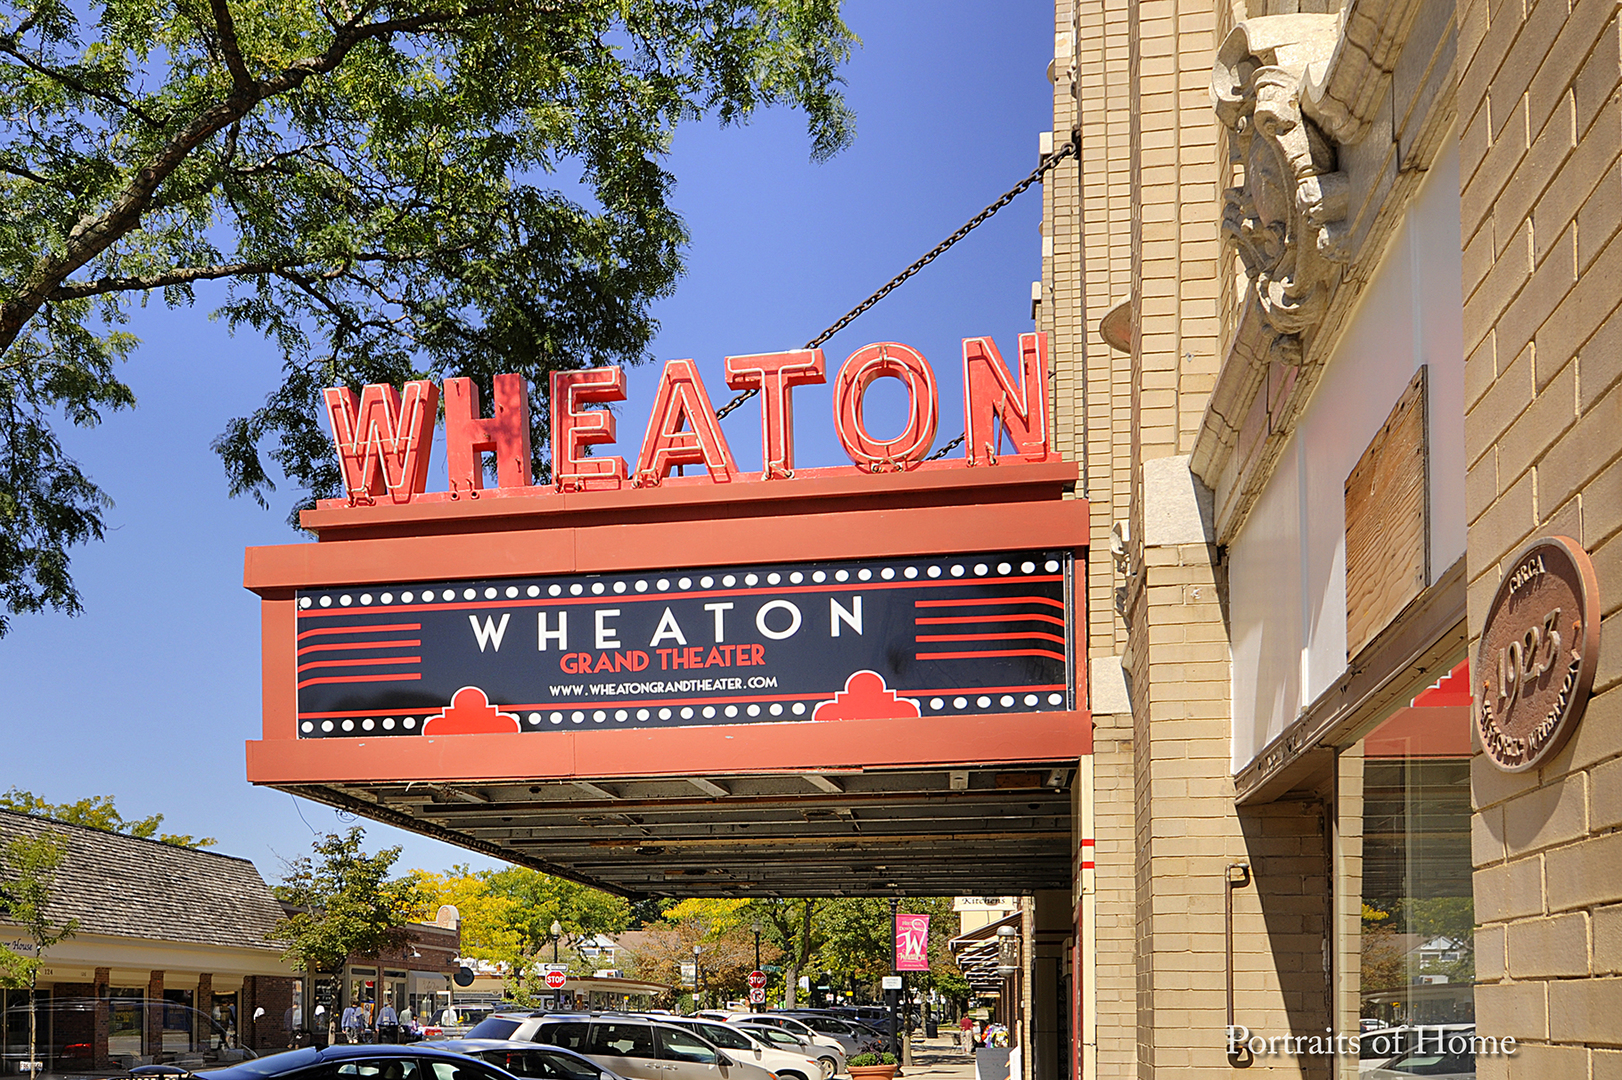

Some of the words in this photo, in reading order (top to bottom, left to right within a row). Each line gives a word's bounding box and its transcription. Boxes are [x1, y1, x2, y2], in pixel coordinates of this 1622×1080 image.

[323, 331, 1049, 503] WHEATON
[1509, 555, 1546, 594] CIRCA
[468, 595, 863, 653] WHEATON
[559, 650, 650, 674] GRAND
[656, 643, 766, 670] THEATER
[1497, 607, 1561, 710] 1923
[12, 938, 33, 951] House
